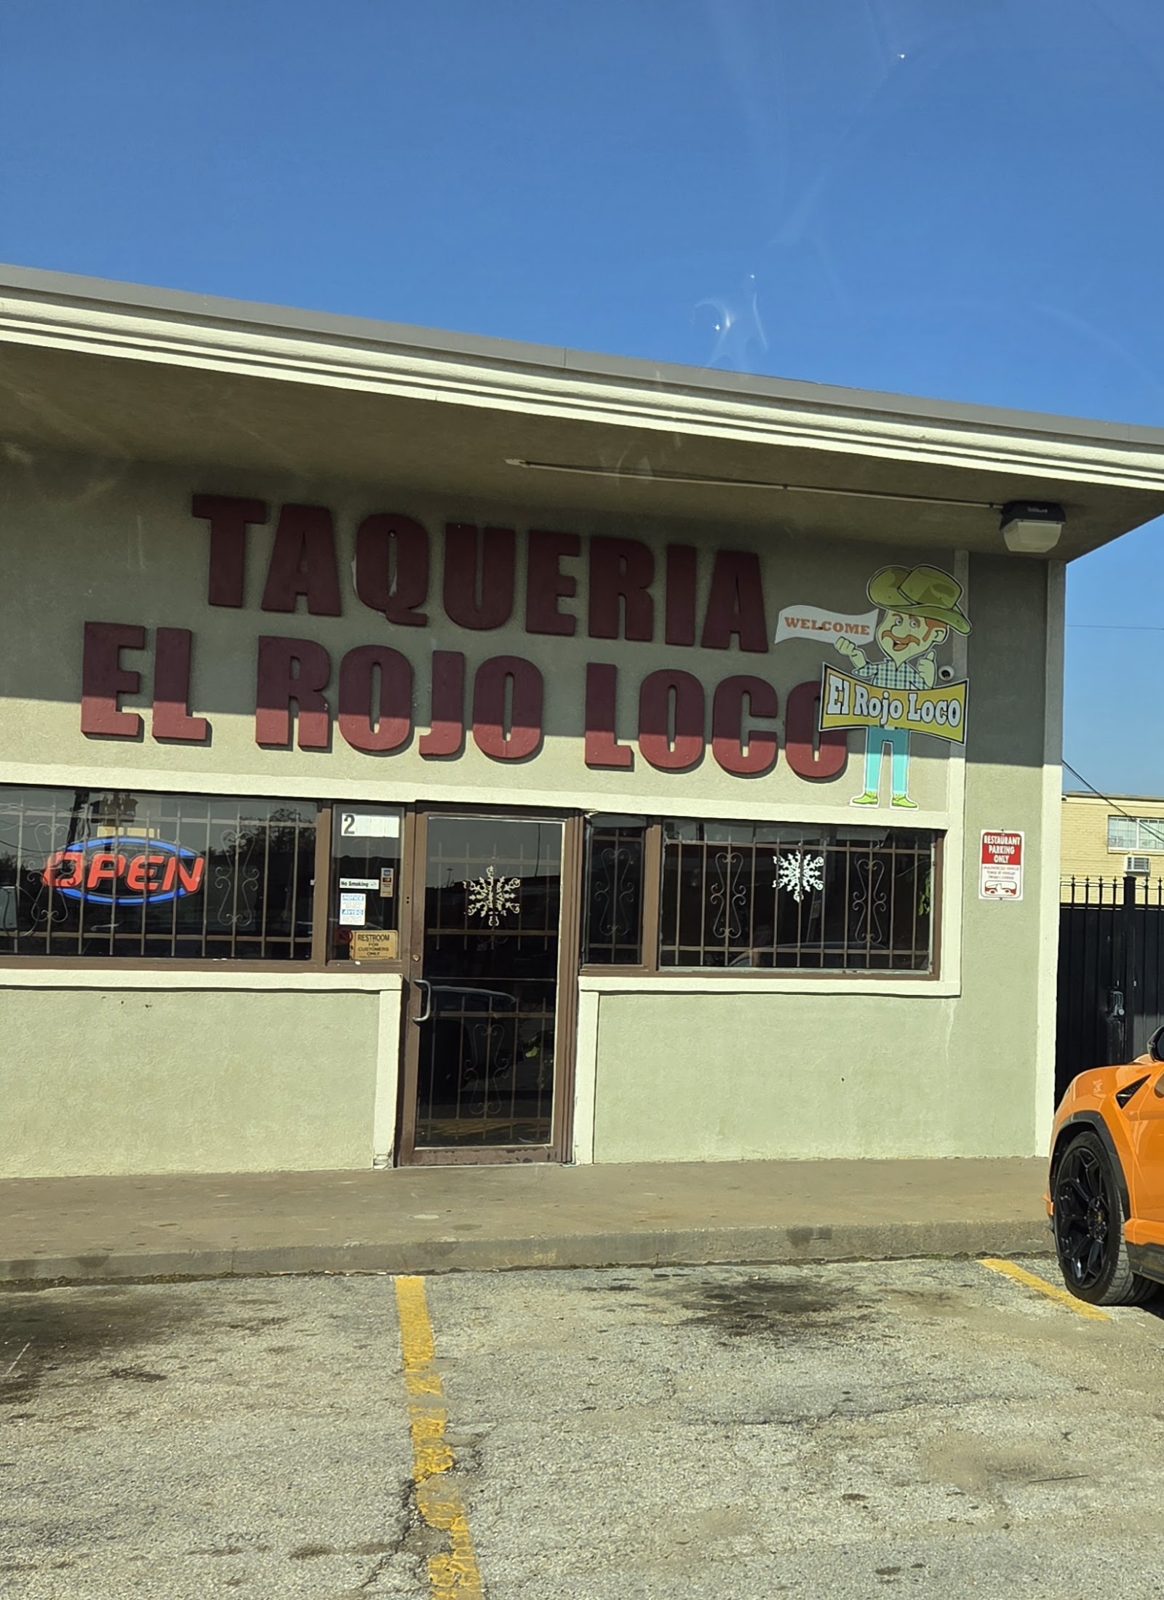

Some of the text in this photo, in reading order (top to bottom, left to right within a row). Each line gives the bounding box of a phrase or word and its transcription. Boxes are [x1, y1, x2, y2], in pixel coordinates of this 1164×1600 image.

[193, 494, 768, 653] TAQUERIA
[784, 616, 871, 636] WELCOME
[81, 621, 847, 778] EL ROJO LOCO
[826, 674, 850, 715] El
[853, 683, 904, 726] Rojo
[343, 814, 355, 835] 2
[984, 835, 1020, 845] RESTAURANT
[988, 845, 1015, 854] PARKING
[993, 855, 1009, 863] ONLY
[43, 851, 204, 893] OPEN
[349, 880, 369, 888] Smoking
[357, 933, 390, 942] RESTROOM
